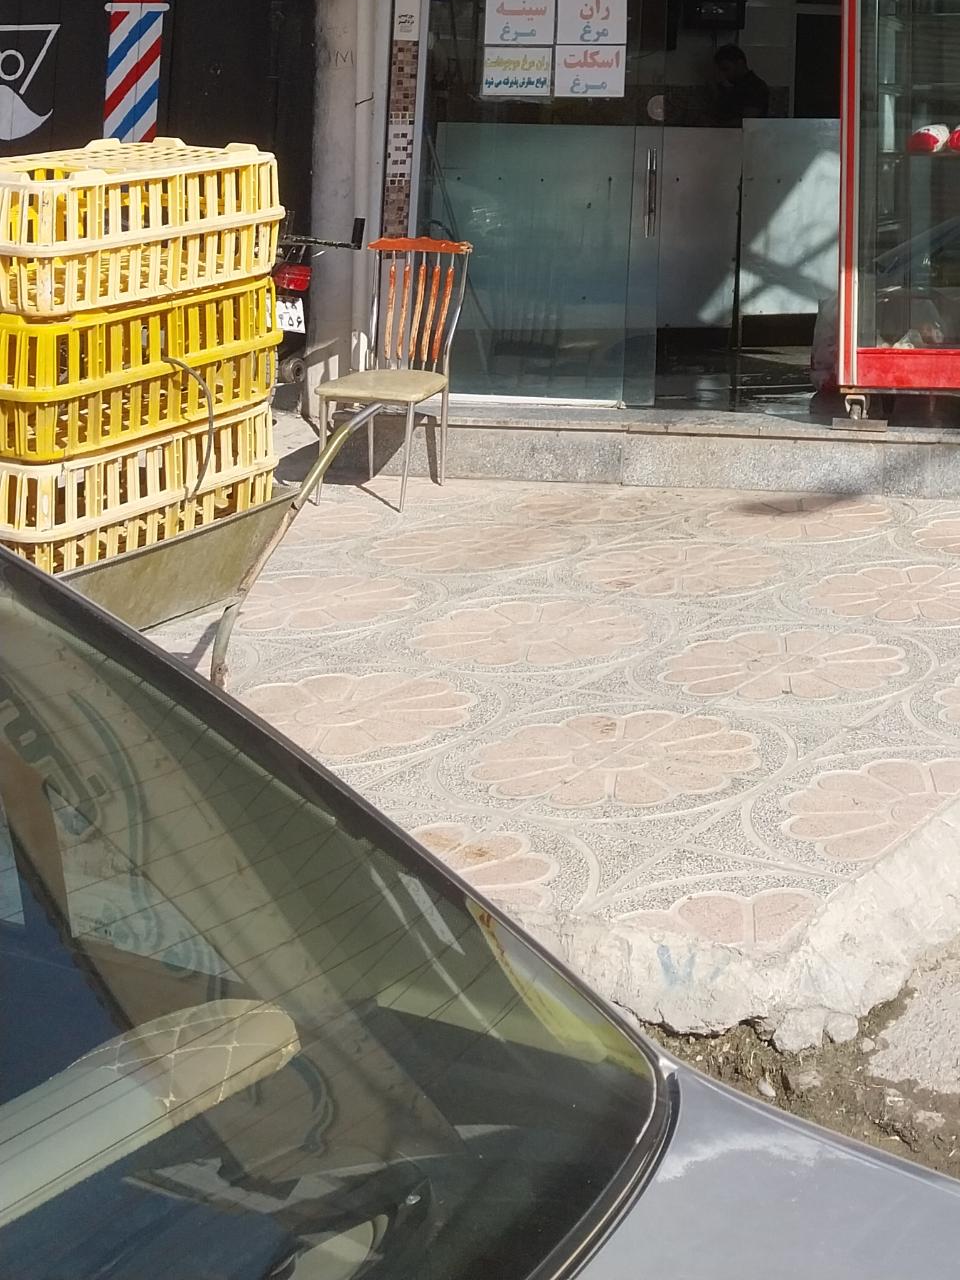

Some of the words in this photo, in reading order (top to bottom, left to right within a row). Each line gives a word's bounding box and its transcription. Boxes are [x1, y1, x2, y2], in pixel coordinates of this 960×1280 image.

[496, 0, 547, 21] سینه
[500, 23, 536, 41] مرغ
[580, 21, 609, 41] مرغ
[570, 75, 608, 94] مرغ
